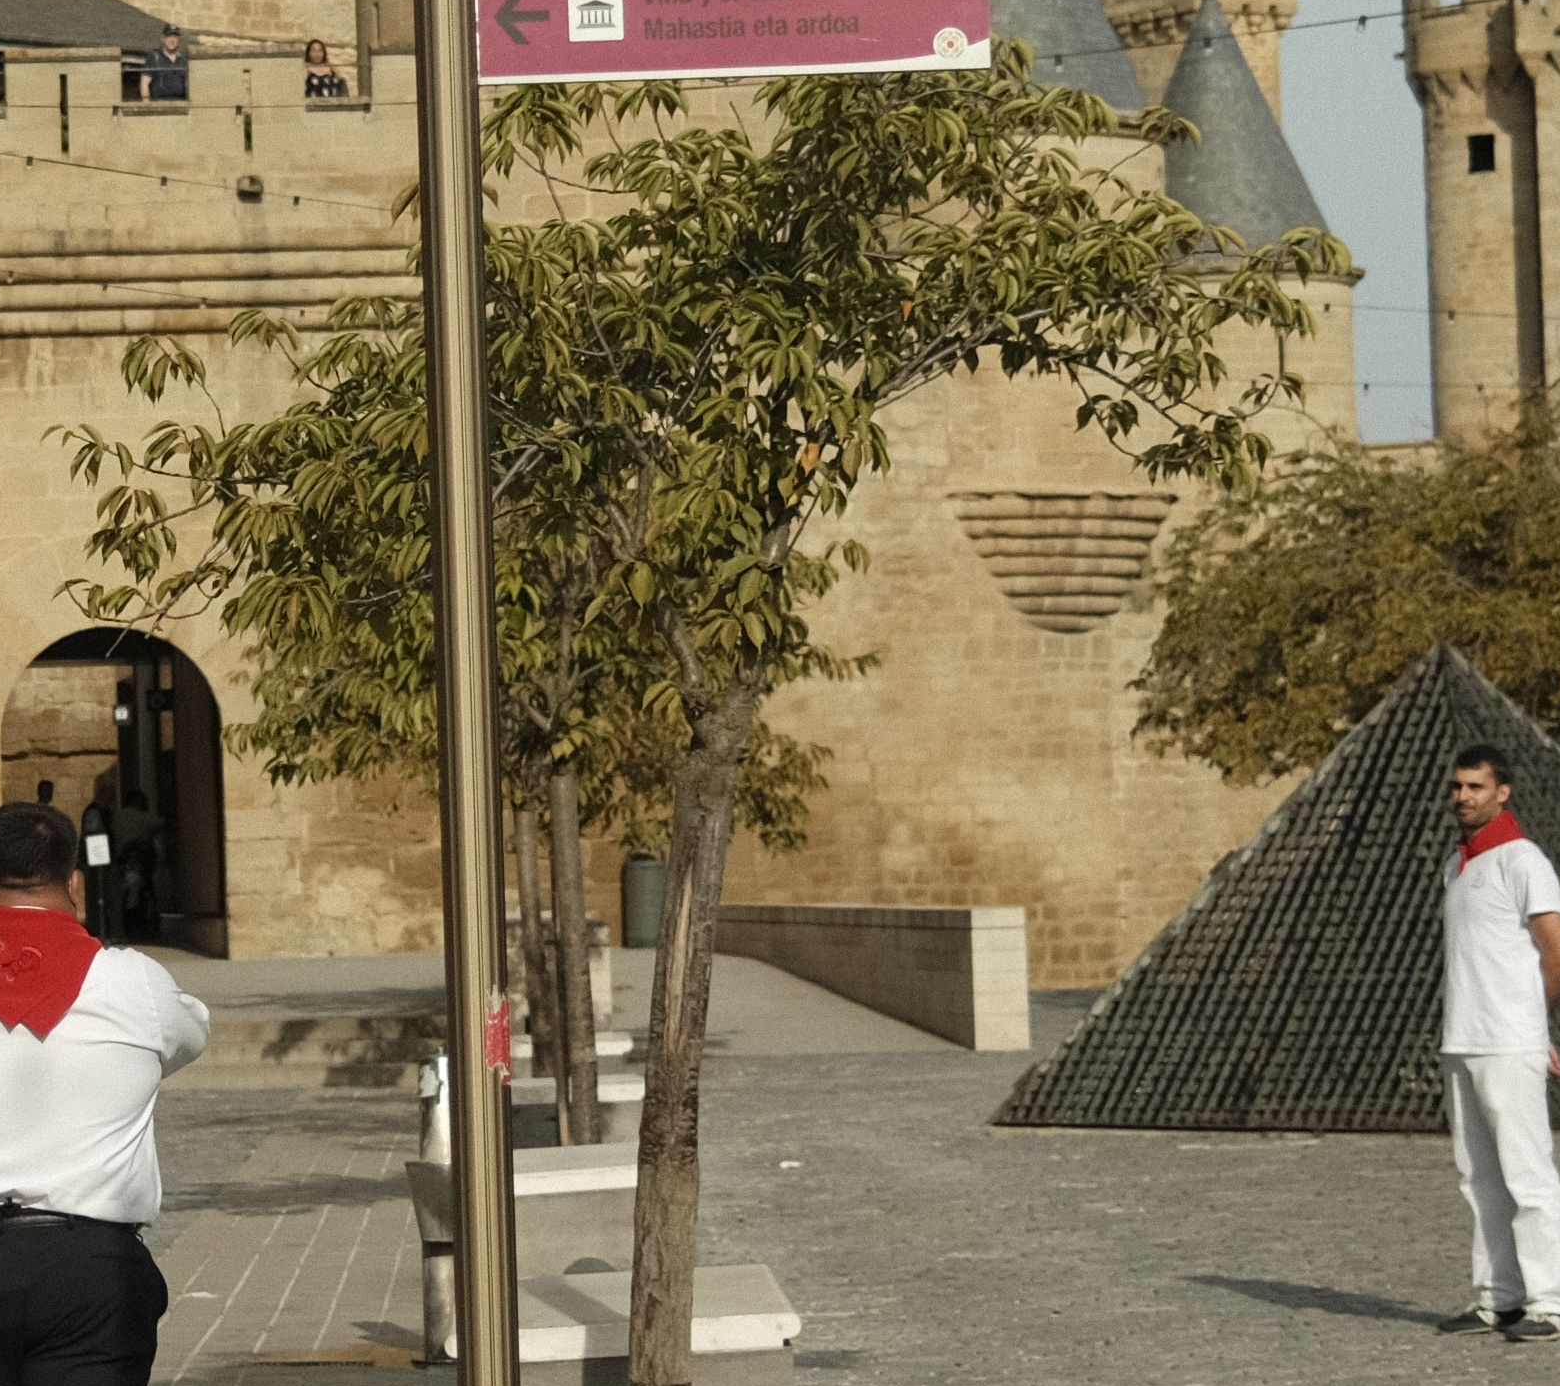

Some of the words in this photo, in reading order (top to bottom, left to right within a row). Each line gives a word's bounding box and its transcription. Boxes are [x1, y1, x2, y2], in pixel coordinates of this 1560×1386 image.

[643, 16, 746, 41] Mahastia
[753, 15, 789, 38] eta
[795, 13, 860, 37] ardoa
